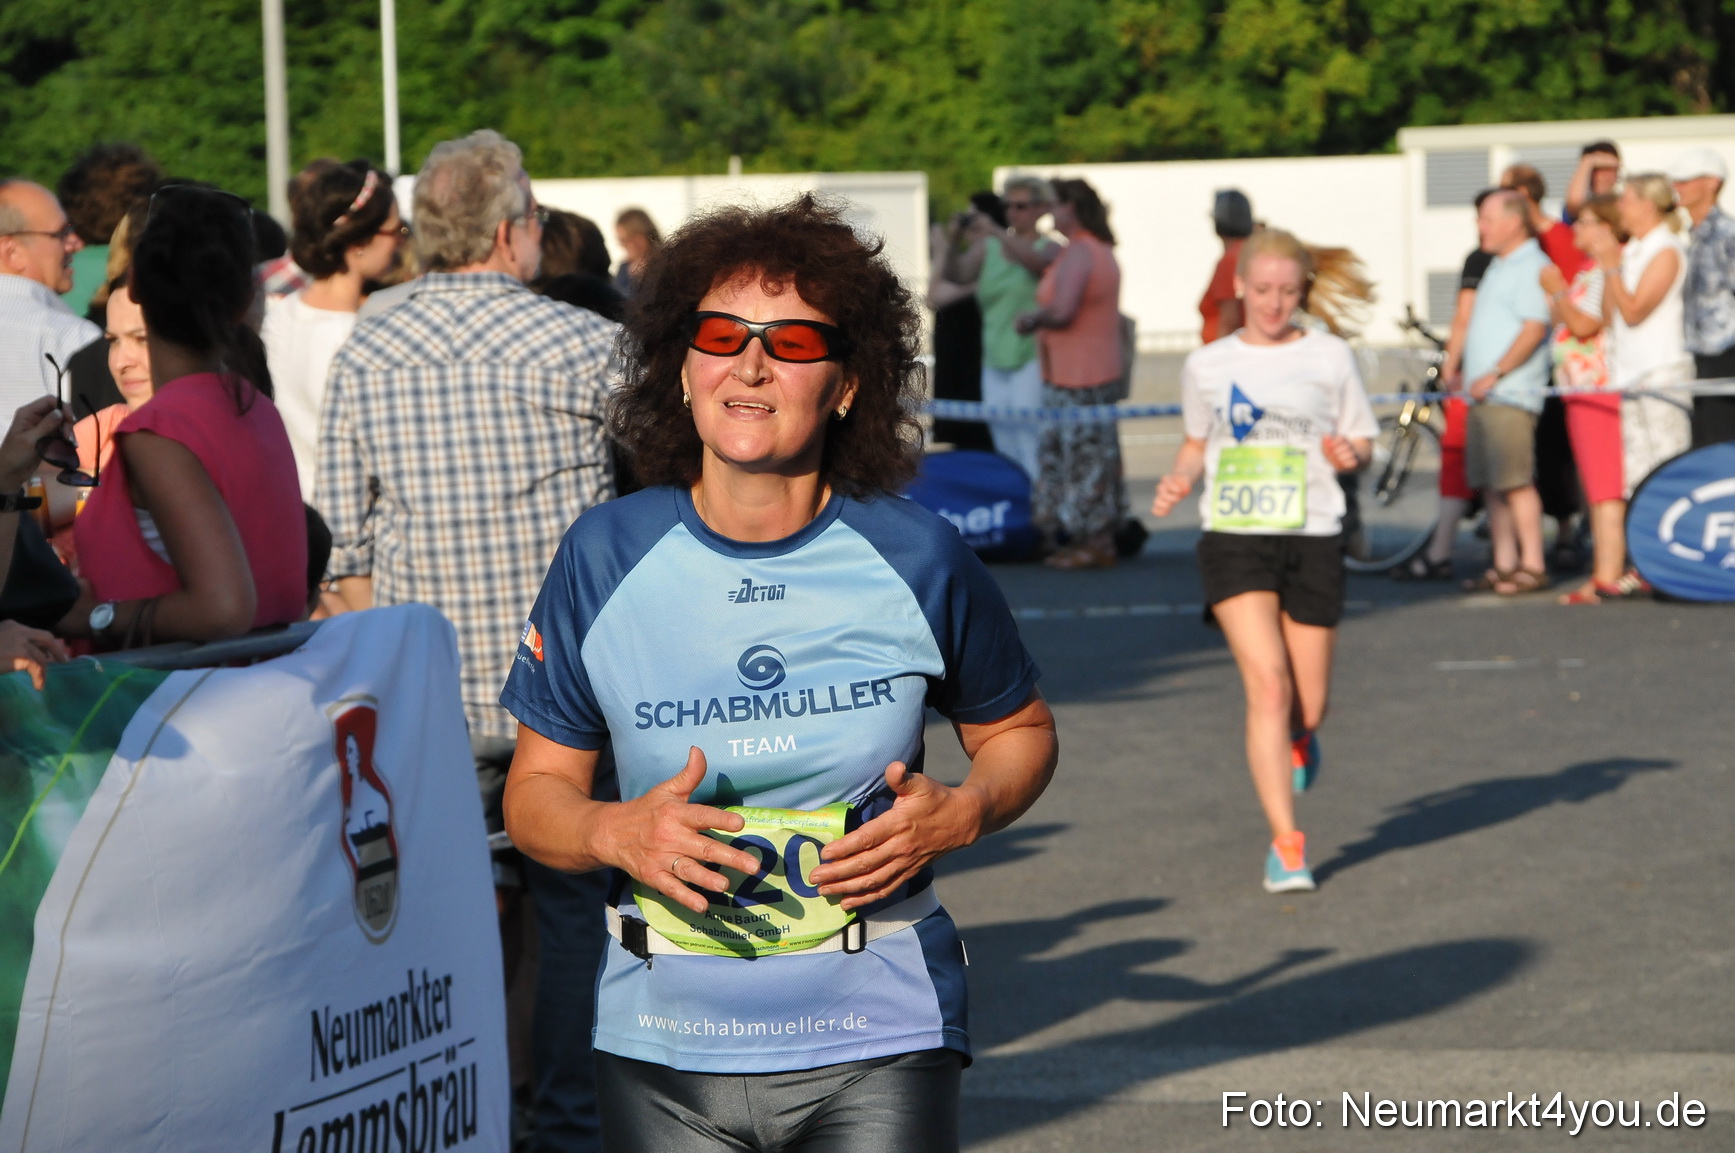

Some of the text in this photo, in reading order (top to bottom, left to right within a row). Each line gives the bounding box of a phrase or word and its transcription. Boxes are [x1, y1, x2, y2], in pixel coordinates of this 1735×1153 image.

[1218, 485, 1297, 516] 5067
[1701, 511, 1735, 552] F
[634, 679, 897, 730] SCHABMÜLLER
[728, 734, 797, 757] TEAM
[704, 909, 771, 925] Anne Baum
[690, 923, 791, 940] Schabmüller GmbH
[310, 968, 453, 1082] Neumarkter
[638, 1012, 868, 1037] www.schabmueller.de
